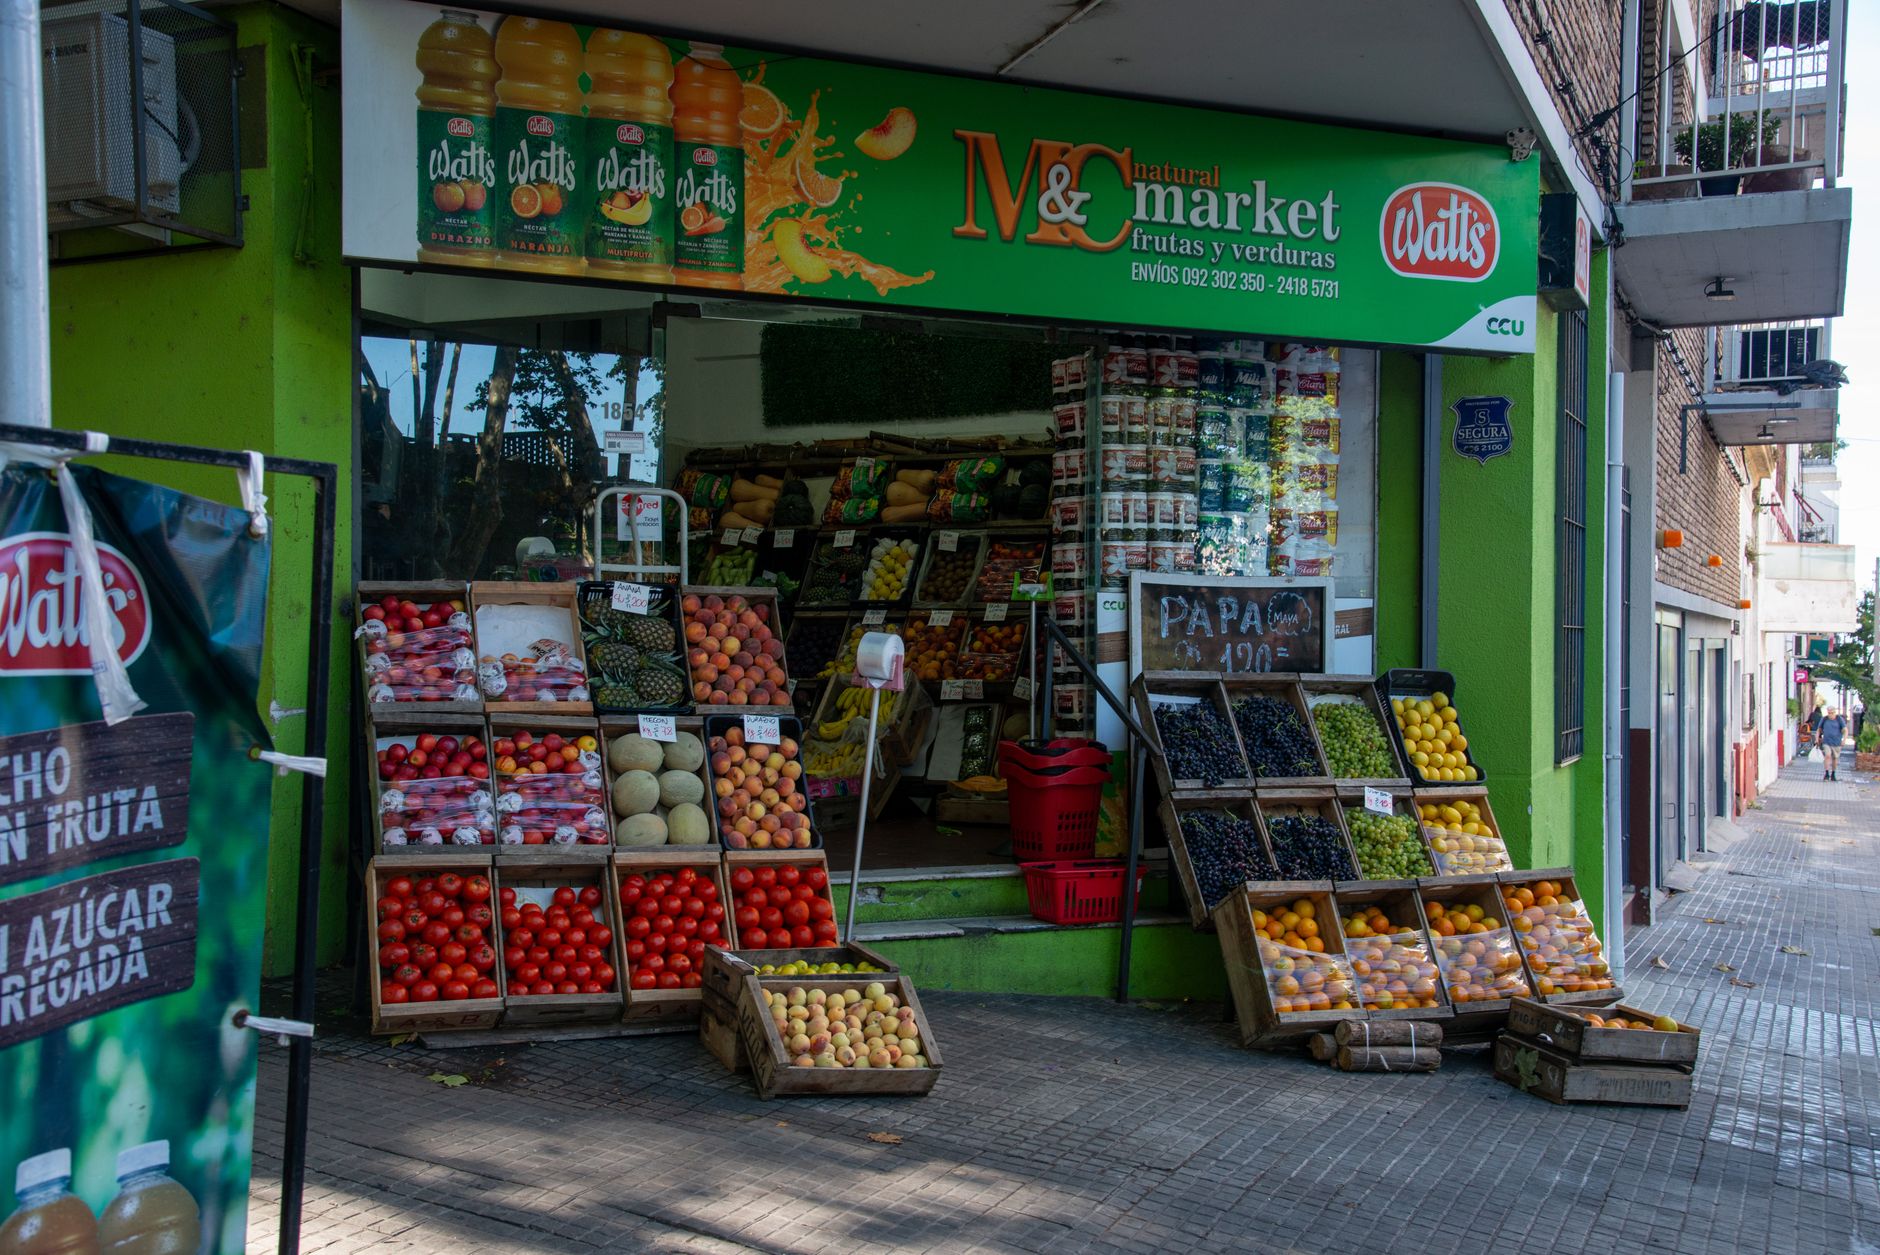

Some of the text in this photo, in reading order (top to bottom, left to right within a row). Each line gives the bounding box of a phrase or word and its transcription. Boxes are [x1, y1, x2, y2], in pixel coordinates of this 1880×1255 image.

[429, 139, 495, 188] Watt's
[508, 139, 576, 191] Watt's
[597, 147, 665, 199] Watt's
[1134, 161, 1219, 187] natural
[676, 168, 737, 214] Watt's
[1132, 180, 1340, 241] market
[431, 233, 491, 245] DURAZNO
[511, 240, 570, 253] NARANJA
[1132, 228, 1335, 269] frutas y verduras
[1392, 191, 1486, 269] Watt's
[607, 248, 654, 258] MULTIFRUTA
[1131, 260, 1179, 284] ENVÍOS
[1183, 267, 1208, 287] 092
[1211, 271, 1236, 289] 302
[1240, 273, 1265, 292] 350
[1277, 276, 1308, 296] 2418
[1312, 279, 1339, 298] 5731
[1486, 317, 1525, 336] CCU
[601, 402, 645, 421] 1854
[1458, 427, 1509, 439] SEGURA
[1103, 601, 1125, 610] CCU
[1160, 596, 1299, 638] PAPA MAYA
[47, 785, 164, 855] FRUTA
[23, 886, 173, 967] AZÚCAR
